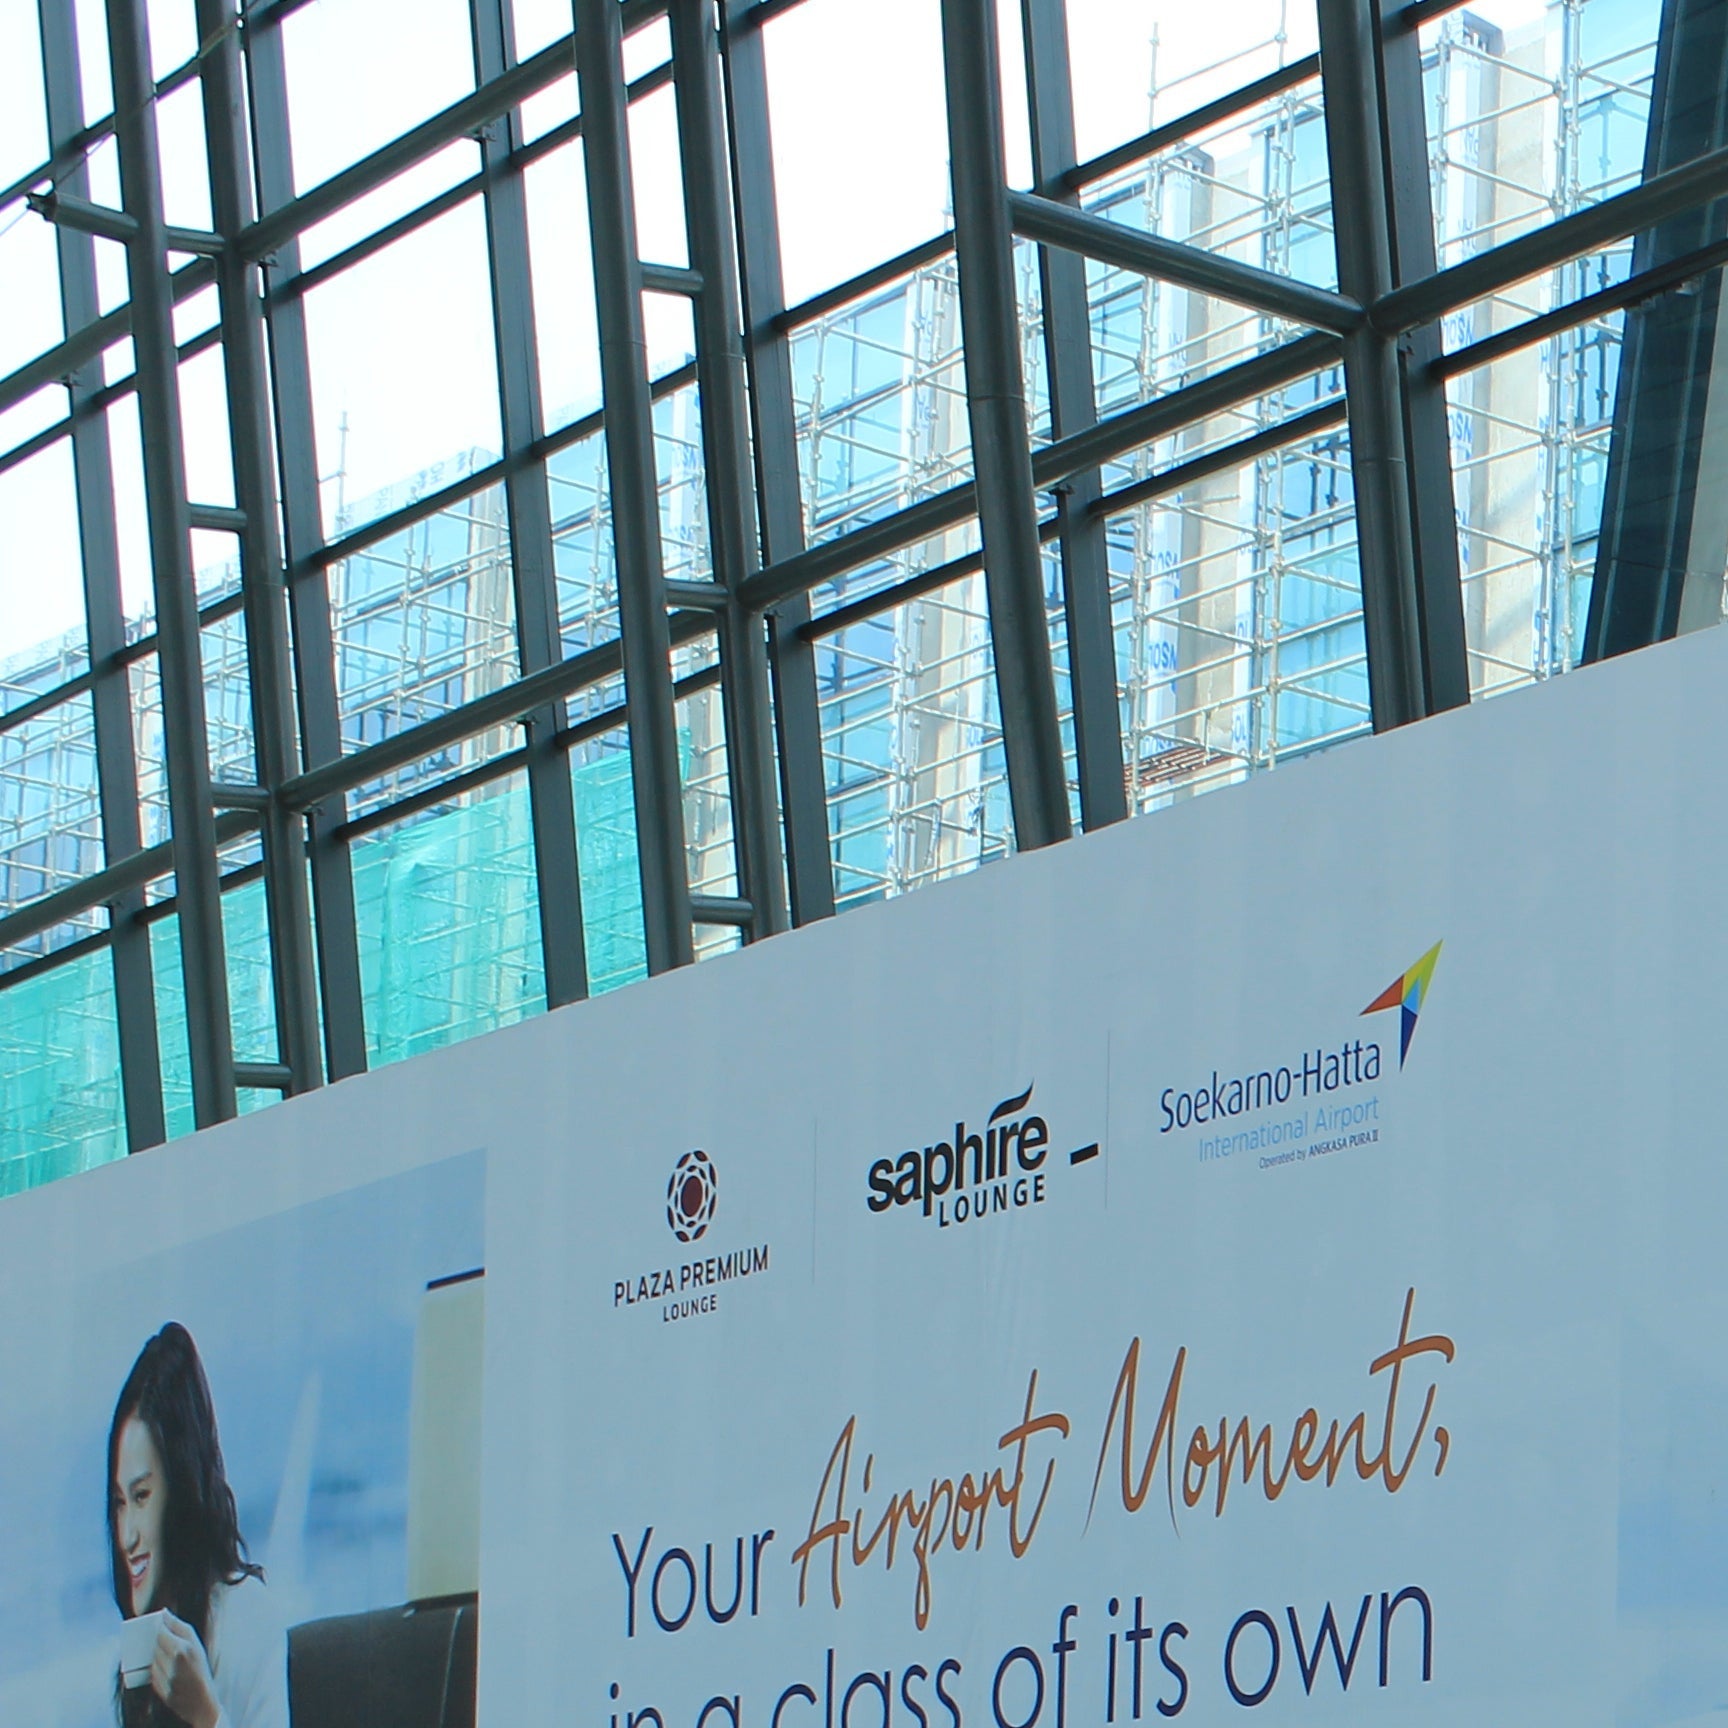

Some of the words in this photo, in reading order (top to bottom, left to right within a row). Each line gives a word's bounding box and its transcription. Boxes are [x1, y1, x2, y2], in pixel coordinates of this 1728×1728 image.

[1160, 1039, 1381, 1133] Soekarno-Hatta
[866, 1077, 1048, 1217] saphire
[1199, 1111, 1308, 1162] International
[1315, 1096, 1379, 1133] Airport
[1259, 1151, 1296, 1169] Operated
[1308, 1138, 1347, 1157] ANGKASA
[1349, 1131, 1372, 1148] PURA
[939, 1174, 1045, 1228] LOUNGE
[614, 1270, 675, 1307] PLAZA
[680, 1244, 768, 1291] PREMIUM
[663, 1294, 717, 1322] LOUNGE
[611, 1526, 775, 1638] Your
[791, 1369, 1070, 1631] Airport
[1081, 1287, 1455, 1541] Moment,
[1106, 1597, 1189, 1724] its
[1223, 1584, 1434, 1707] own
